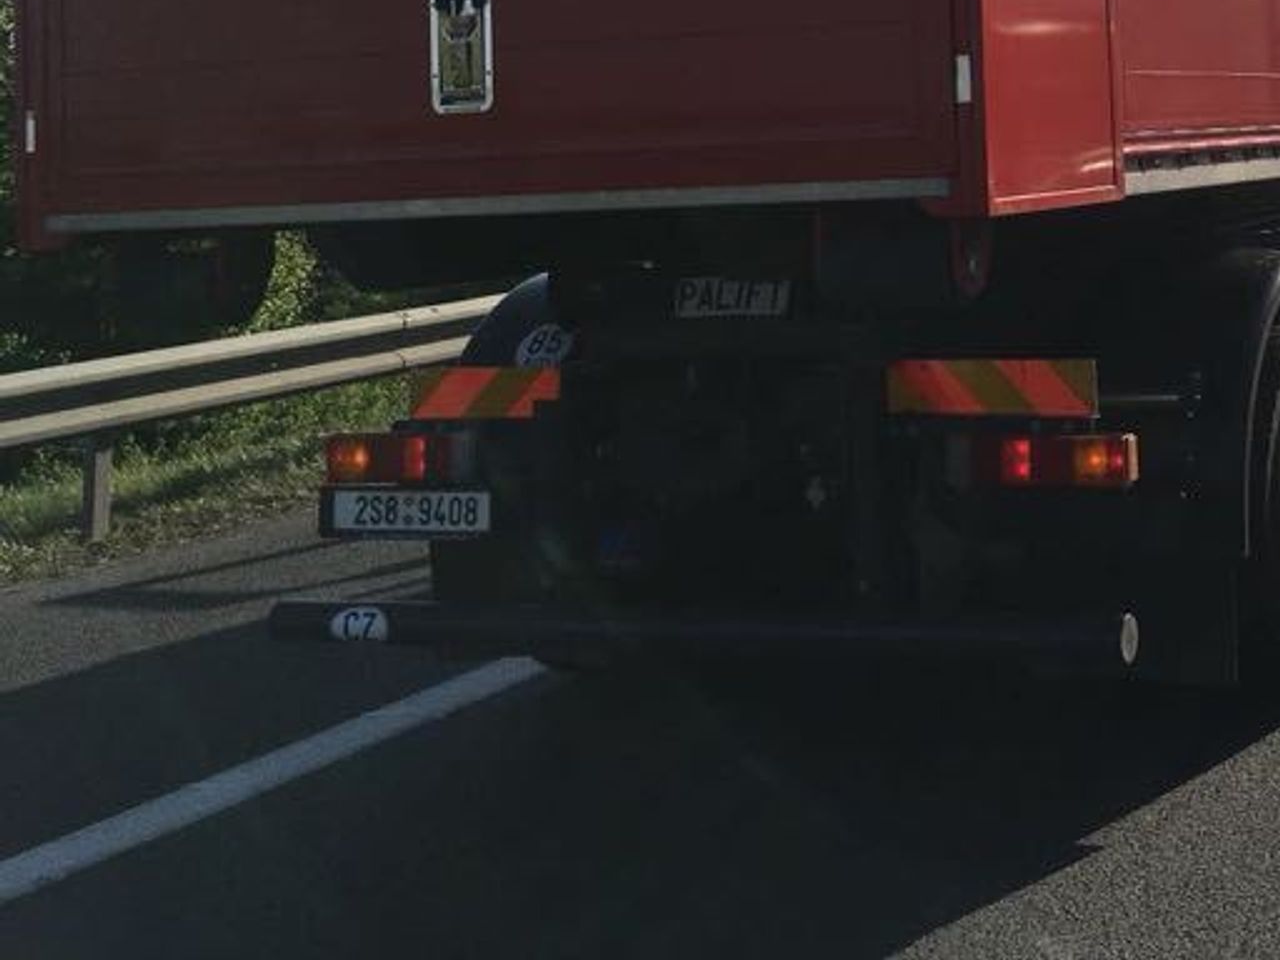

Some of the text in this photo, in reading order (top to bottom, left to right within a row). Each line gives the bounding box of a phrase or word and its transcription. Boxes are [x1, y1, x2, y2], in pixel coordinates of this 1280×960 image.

[353, 495, 479, 527] 2S8 9408
[343, 612, 378, 641] CZ
